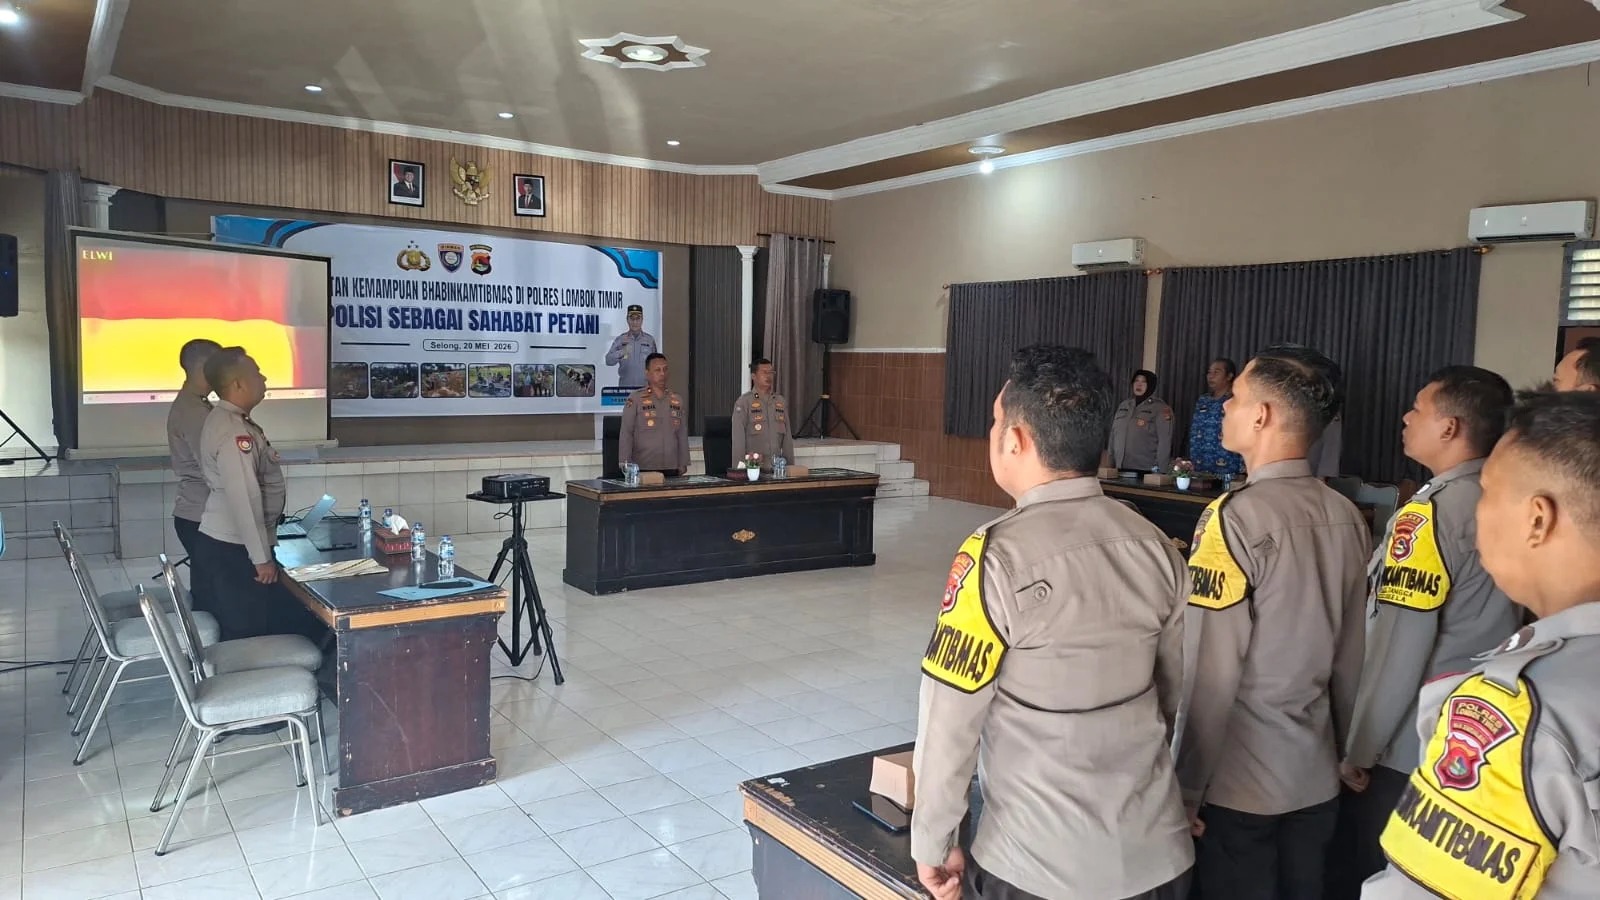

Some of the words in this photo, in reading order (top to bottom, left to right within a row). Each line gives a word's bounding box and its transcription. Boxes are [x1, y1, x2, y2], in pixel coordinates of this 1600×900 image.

[82, 249, 113, 261] ELWI
[352, 277, 418, 300] KEMAMPUAN
[421, 280, 513, 305] BHABINKAMTIBMAS
[516, 286, 524, 305] DI
[527, 286, 559, 306] POLRES
[561, 288, 596, 308] LOMBOK
[598, 290, 623, 309] TIMUR
[388, 306, 463, 331] SEBAGAI
[468, 309, 543, 333] SAHABAT
[549, 313, 600, 335] PETANI
[430, 341, 462, 351] Selong,
[463, 342, 473, 350] 20
[475, 342, 490, 350] MEI
[1457, 702, 1504, 729] POLRES
